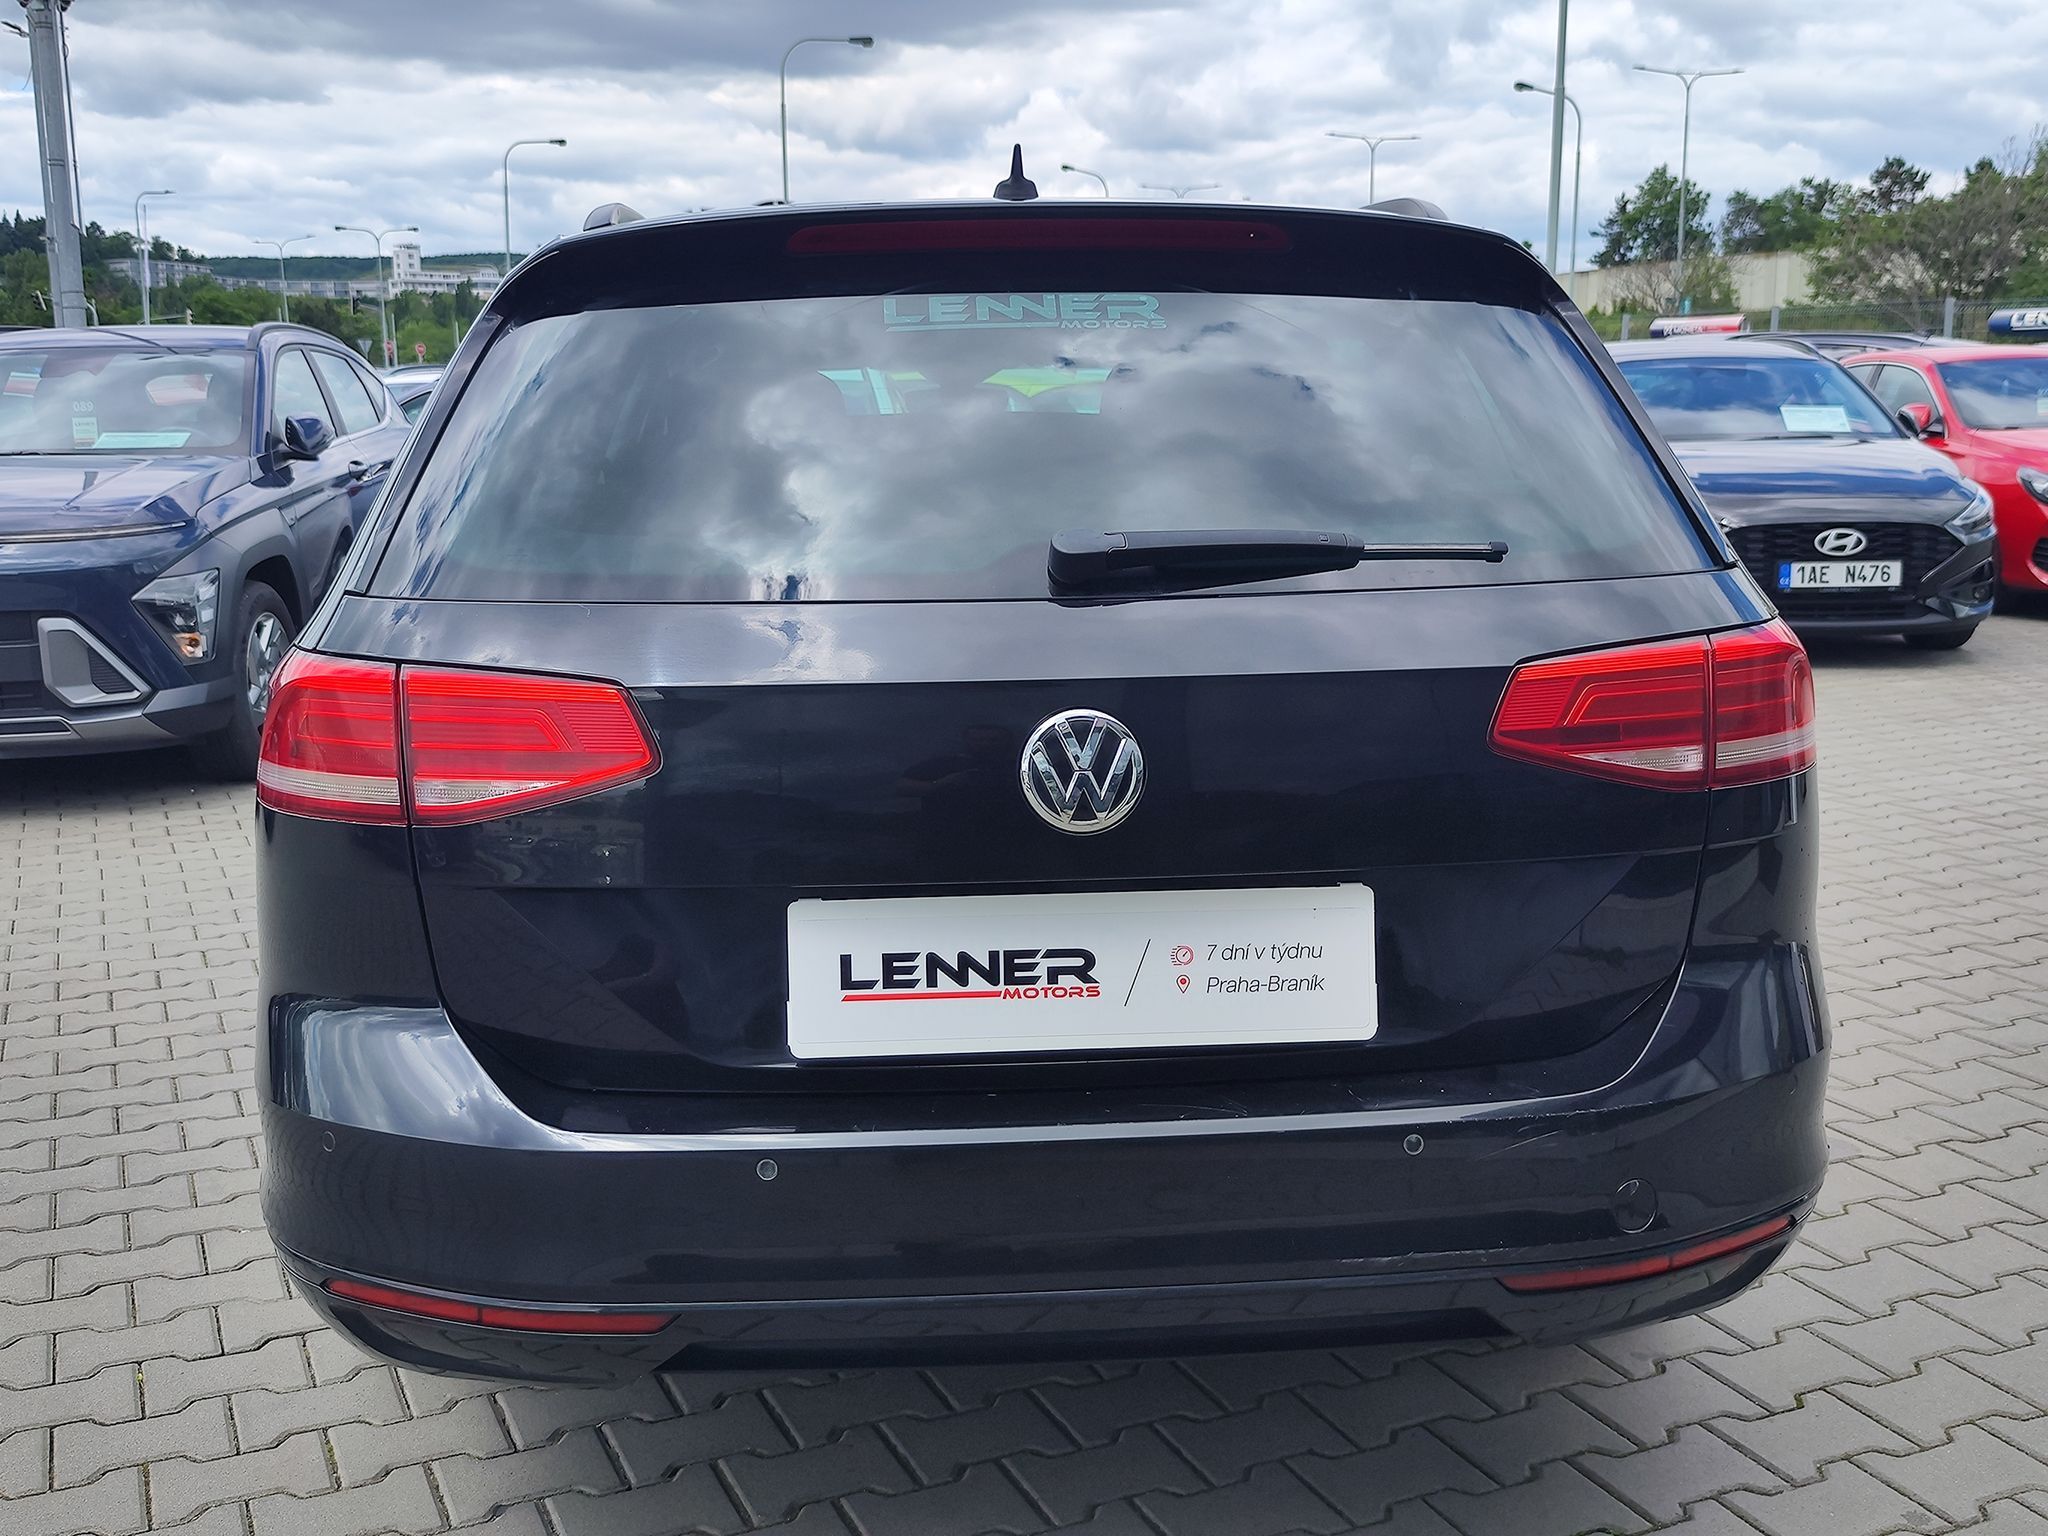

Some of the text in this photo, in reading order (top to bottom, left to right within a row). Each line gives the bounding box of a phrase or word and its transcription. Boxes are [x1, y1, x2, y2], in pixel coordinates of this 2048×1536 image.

[883, 294, 1165, 323] LENNER
[1060, 319, 1167, 329] MOTORS
[1796, 564, 1891, 584] 1AE N476
[1207, 942, 1323, 964] 7 dní v týdnu
[840, 948, 1100, 991] LENNER
[1002, 986, 1101, 1000] MOTORS
[1206, 974, 1325, 994] Praha-Braník
